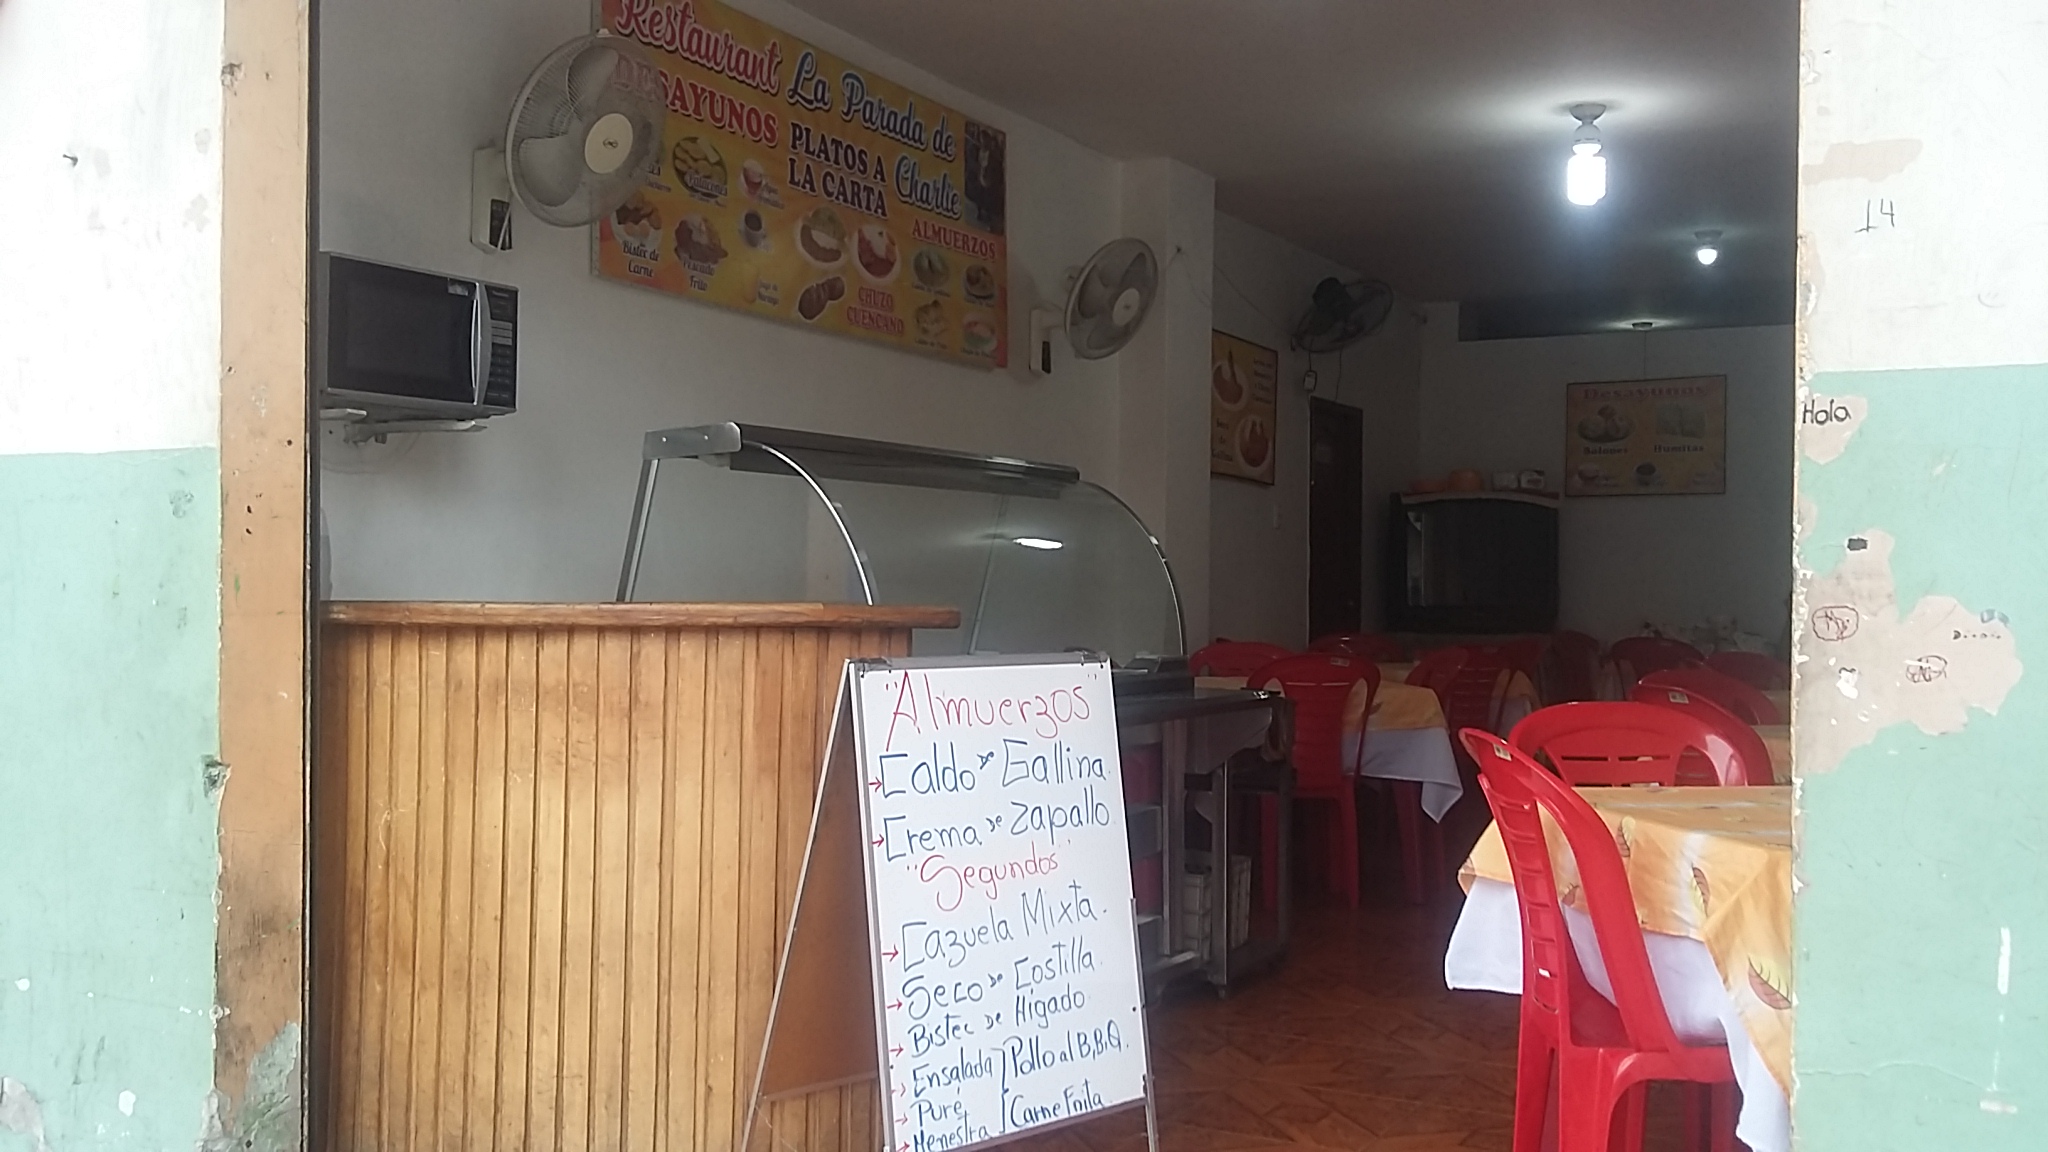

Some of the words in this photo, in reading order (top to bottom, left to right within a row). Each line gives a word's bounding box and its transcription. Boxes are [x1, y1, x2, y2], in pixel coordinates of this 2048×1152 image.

[616, 0, 782, 95] Restaurant
[786, 51, 833, 110] La
[841, 71, 928, 147] Parada
[932, 115, 957, 162] de
[790, 121, 868, 177] PLATOS
[869, 154, 888, 184] A
[788, 158, 817, 199] LA
[821, 167, 888, 219] CARTA
[895, 154, 963, 221] Charlie
[912, 217, 996, 261] ALMUERZOS
[628, 260, 654, 278] Carne
[846, 305, 905, 337] CUENCANO
[858, 286, 894, 313] CHUZO
[1801, 398, 1852, 426] Hola
[879, 742, 976, 798] Caldo
[883, 815, 983, 862] Crema
[901, 905, 1014, 972] Cazuela
[901, 975, 984, 1020] Seco
[907, 1014, 975, 1058] Bistec
[1002, 1035, 1056, 1078] Pollo
[912, 1046, 993, 1098] Ensalada
[1010, 1094, 1061, 1128] Carne
